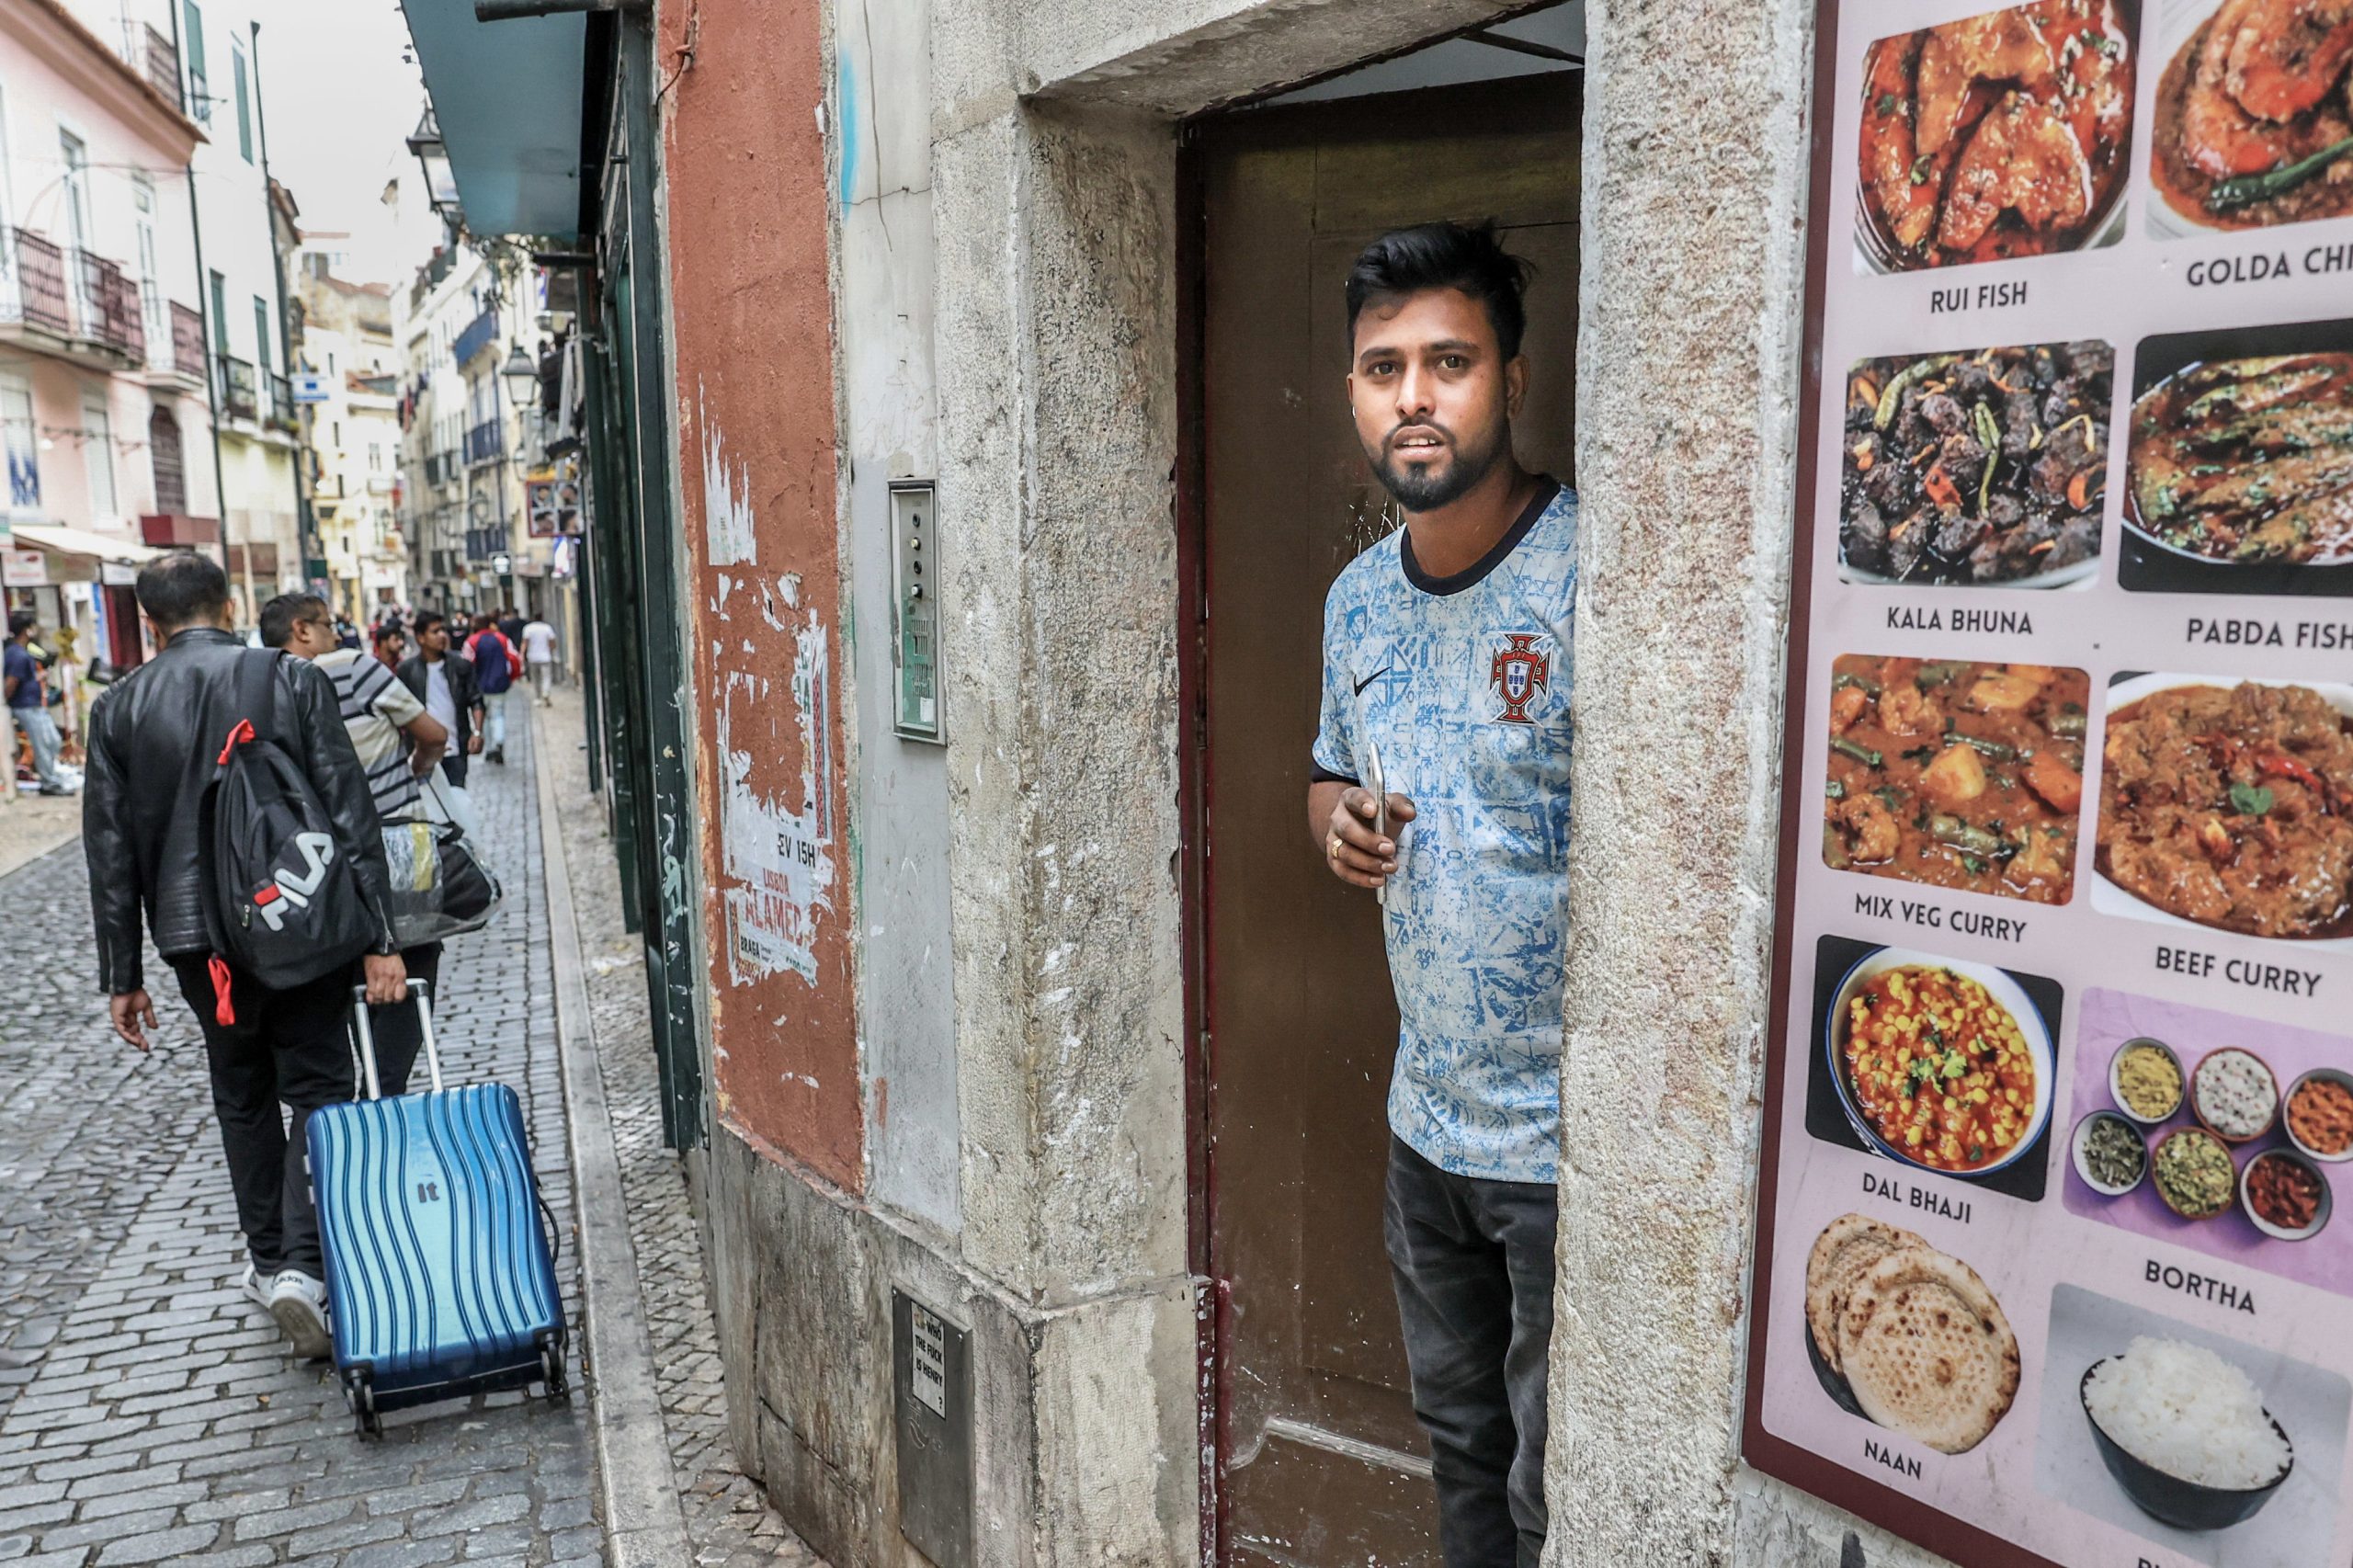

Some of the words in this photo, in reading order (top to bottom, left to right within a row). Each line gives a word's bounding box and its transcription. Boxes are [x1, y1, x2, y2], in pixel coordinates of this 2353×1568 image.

[2186, 251, 2291, 288] GOLDA
[1930, 286, 1969, 314] RUI
[1977, 280, 2028, 310] FISH
[1887, 606, 1942, 631] KALA
[1950, 608, 2033, 635] BHUNA
[2187, 618, 2284, 647] PABDA
[2296, 622, 2353, 651] FISH
[797, 841, 816, 868] 15H
[253, 832, 335, 931] FILA
[763, 868, 790, 897] LISBOA
[1855, 892, 1893, 920] MIX
[1900, 900, 1941, 928] VEG
[1949, 910, 2028, 943] CURRY
[740, 936, 760, 960] BRAGA
[2155, 946, 2216, 979] BEEF
[2224, 959, 2323, 997] CURRY
[1862, 1172, 1903, 1203] DAL
[1909, 1187, 1972, 1224] BHAJI
[2144, 1258, 2256, 1315] BORTHA
[926, 1320, 942, 1342] WHO
[915, 1334, 926, 1354] THE
[927, 1344, 942, 1365] FUCK
[916, 1357, 922, 1371] IS
[923, 1360, 942, 1387] HENRY
[938, 1396, 943, 1410] ?
[1863, 1438, 1923, 1481] NAAN
